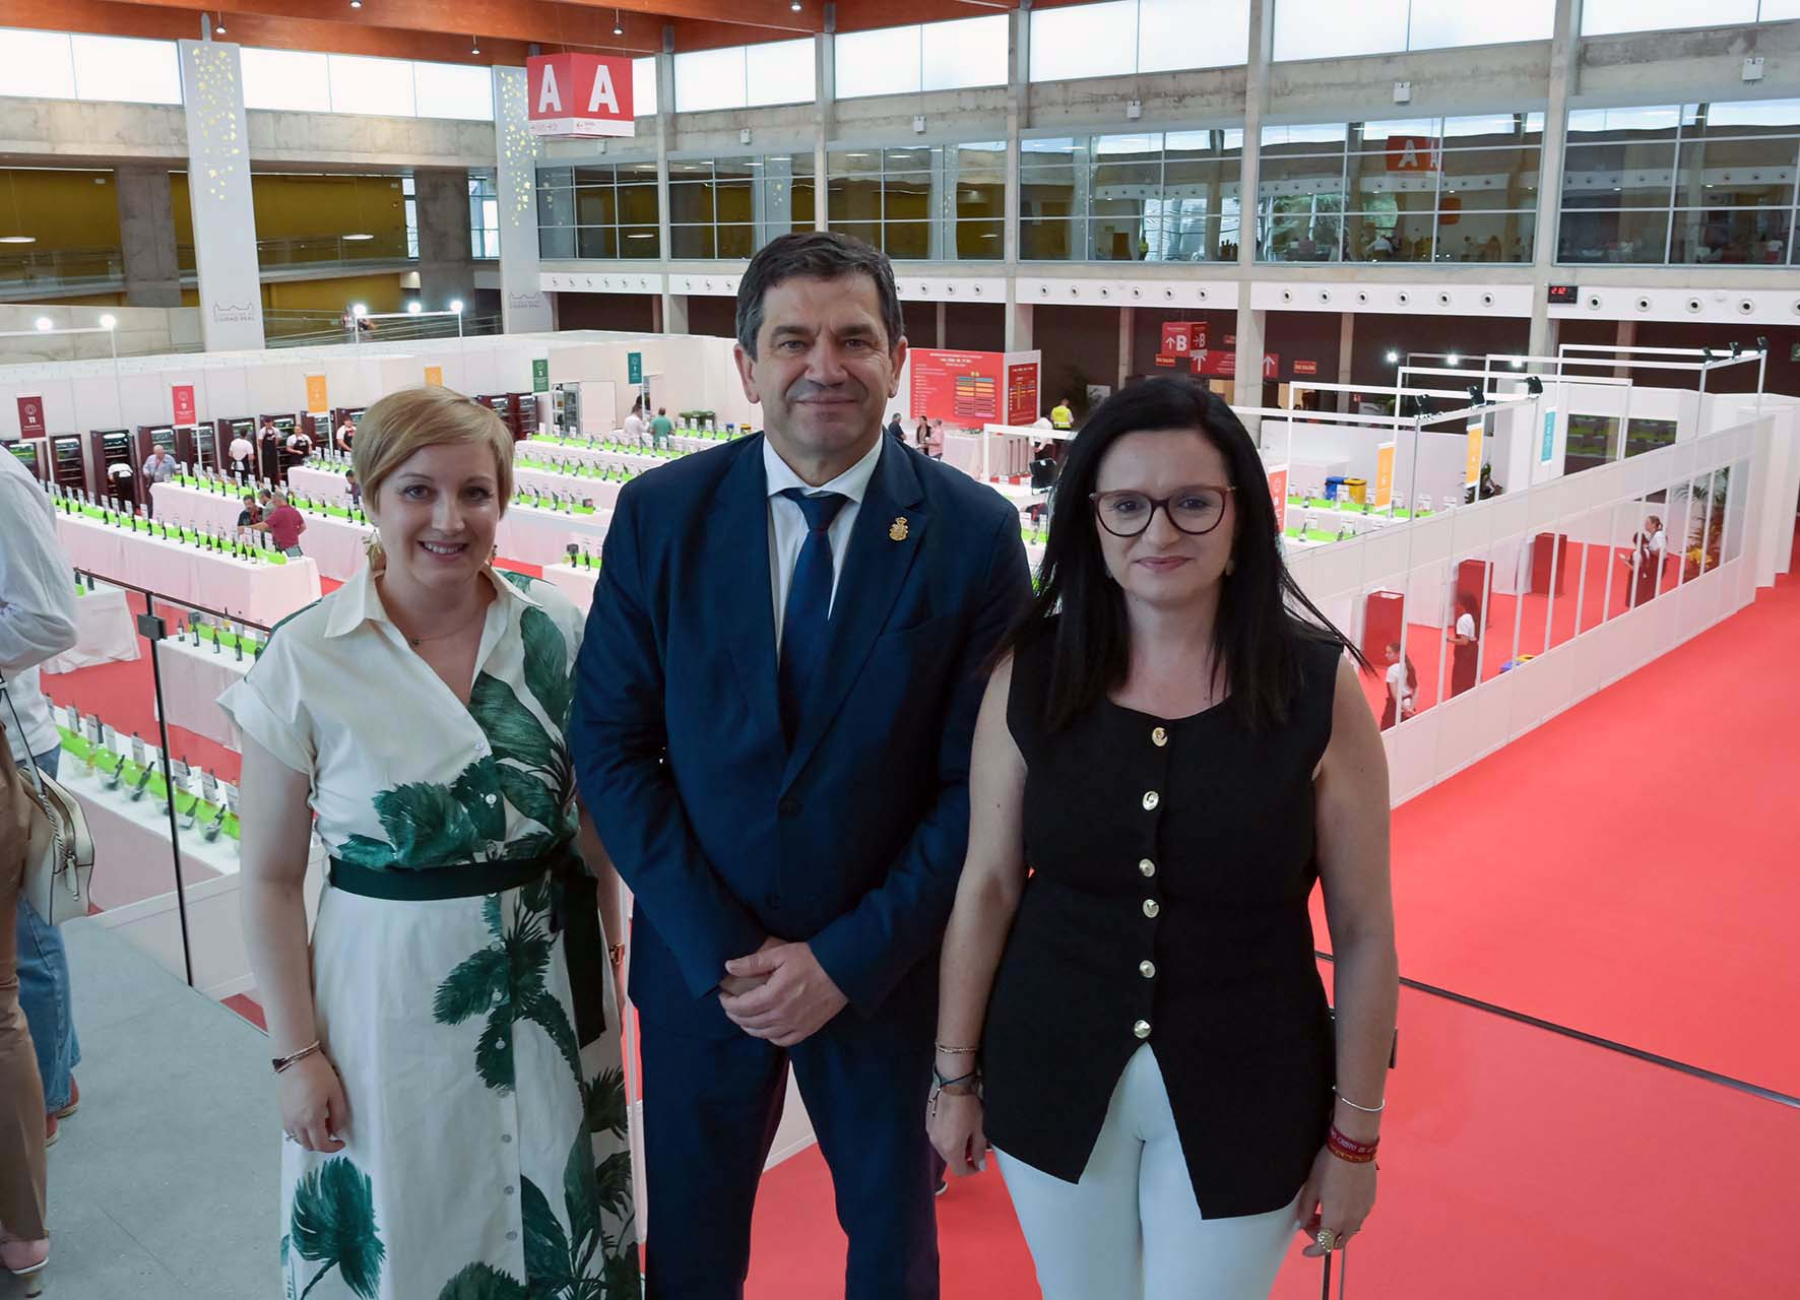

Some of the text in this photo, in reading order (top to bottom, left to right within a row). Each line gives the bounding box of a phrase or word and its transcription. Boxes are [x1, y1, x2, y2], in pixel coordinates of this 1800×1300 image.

[538, 64, 562, 113] A
[587, 64, 620, 114] A
[1176, 335, 1187, 352] B
[1199, 333, 1206, 348] B
